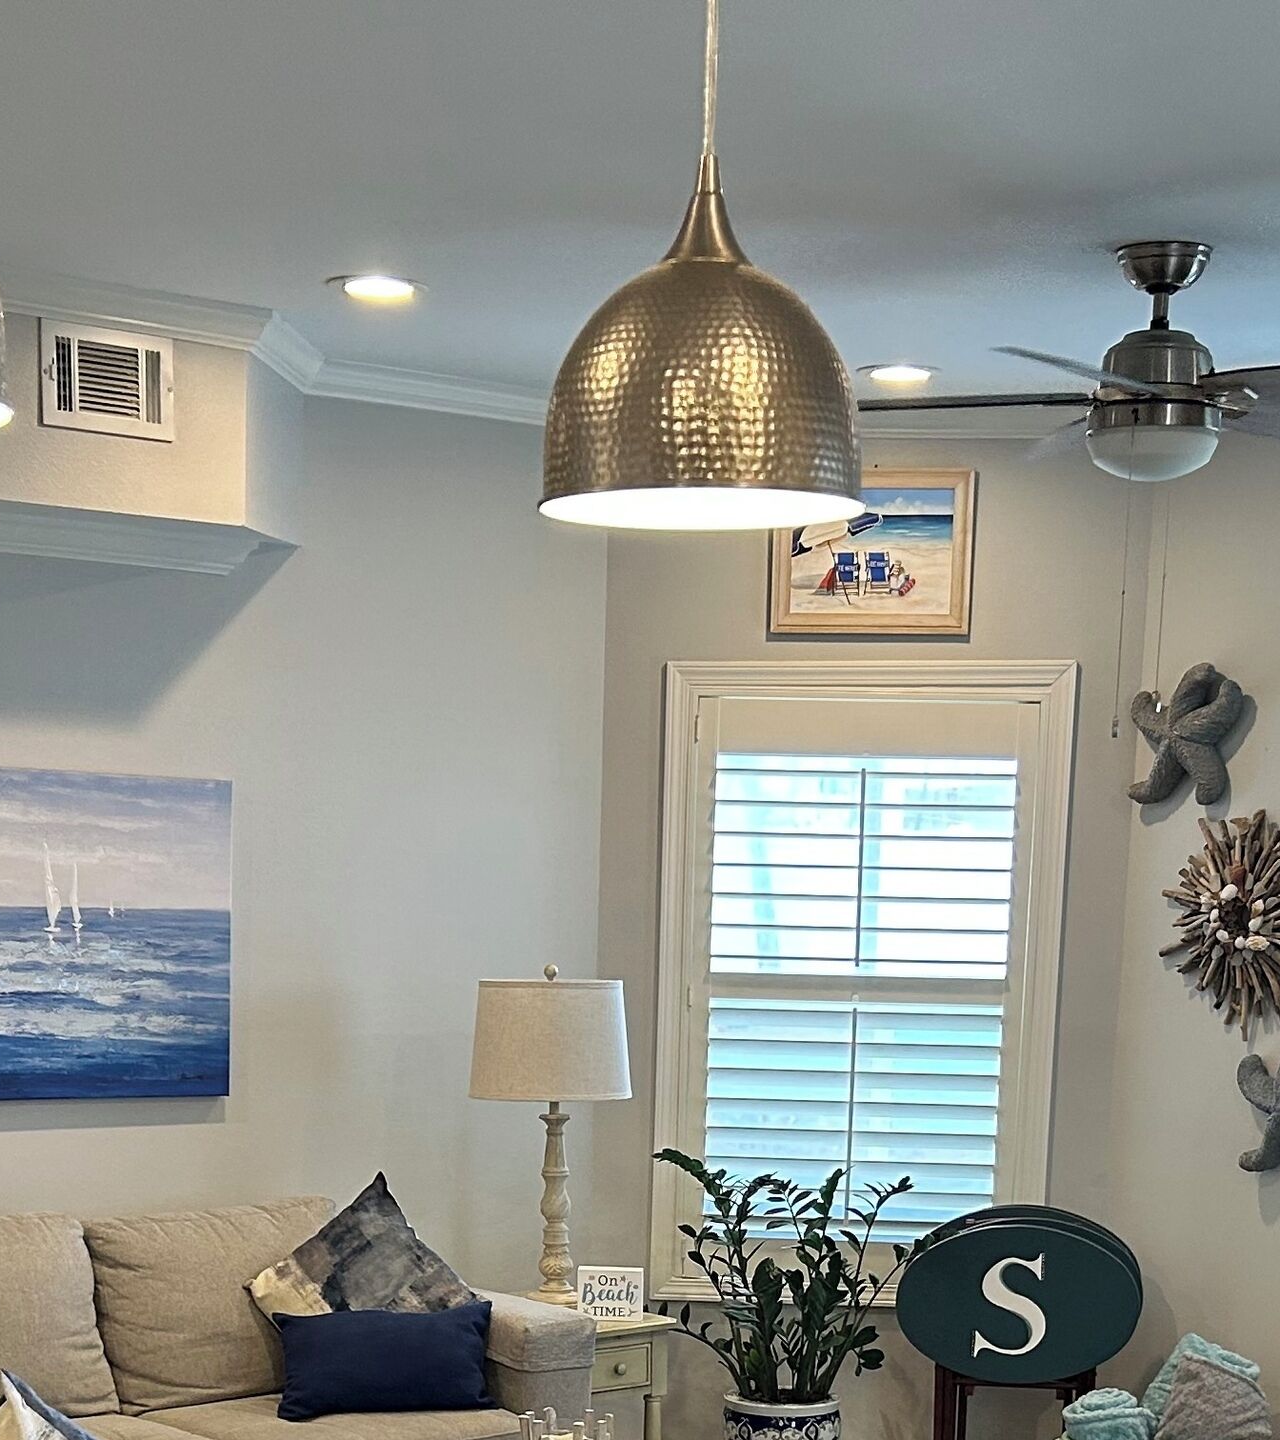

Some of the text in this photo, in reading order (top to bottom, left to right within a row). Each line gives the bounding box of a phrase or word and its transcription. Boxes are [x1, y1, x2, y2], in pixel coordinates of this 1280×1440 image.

[597, 1274, 619, 1287] On
[581, 1280, 639, 1306] Beach
[590, 1305, 626, 1317] TIME
[972, 1252, 1047, 1358] S
